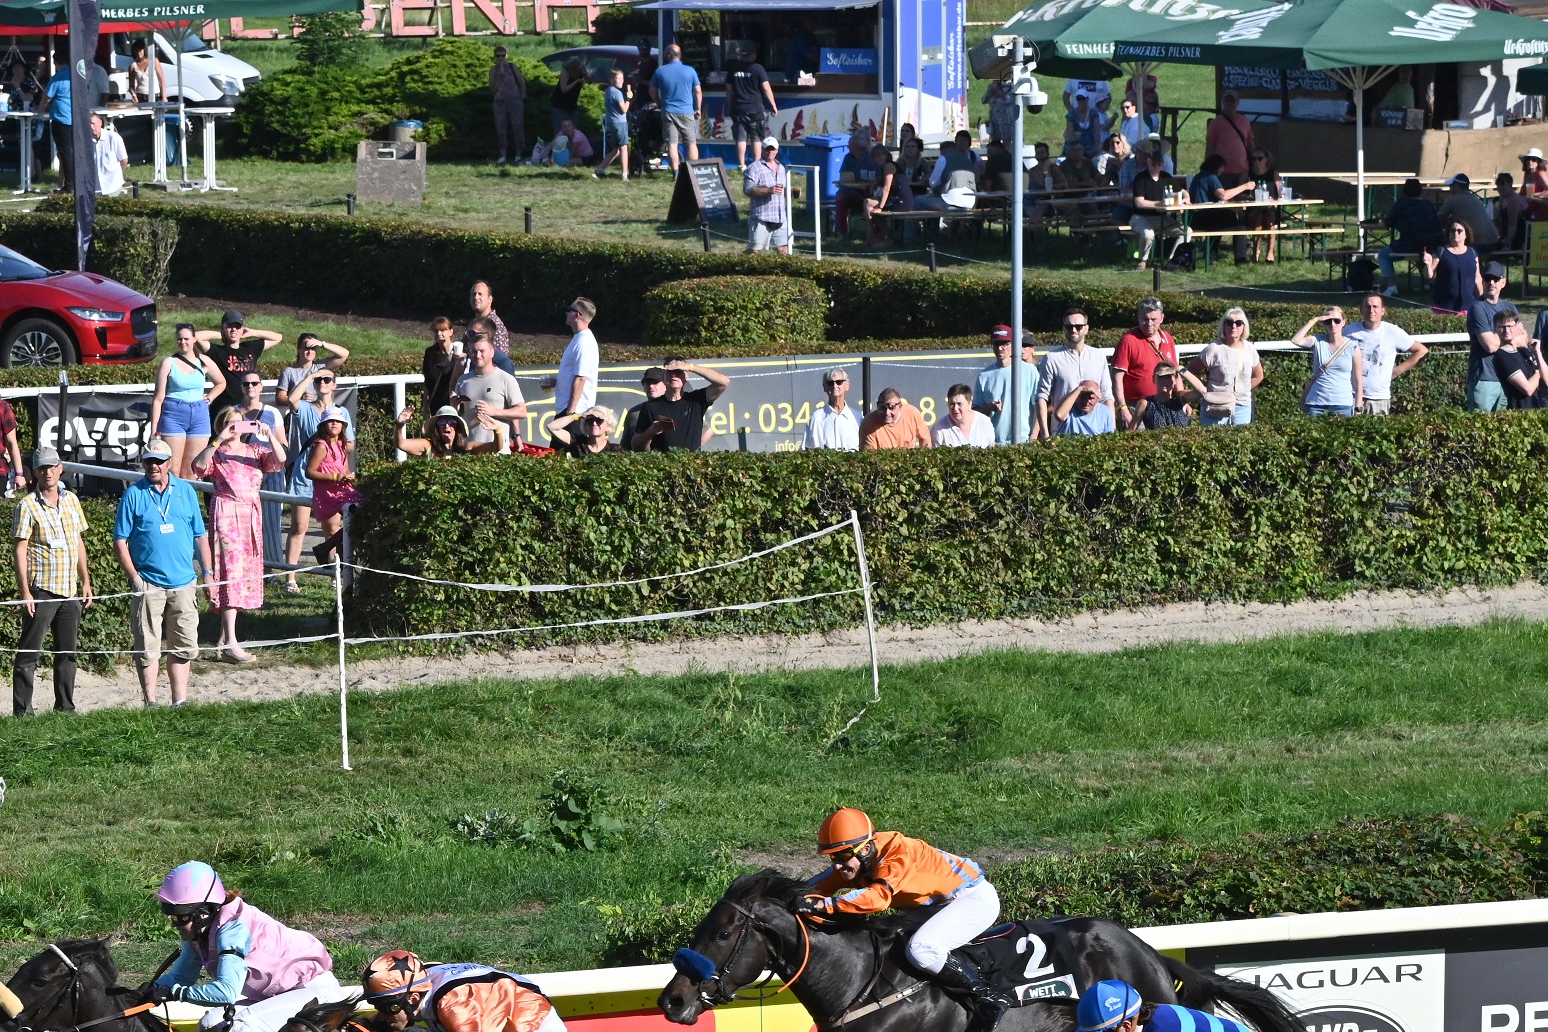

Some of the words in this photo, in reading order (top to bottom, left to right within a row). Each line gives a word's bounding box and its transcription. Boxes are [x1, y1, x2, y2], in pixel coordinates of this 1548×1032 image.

[153, 4, 205, 16] PILSNER
[1117, 45, 1165, 57] FEINHERBES
[1167, 46, 1201, 58] PILSNER
[826, 53, 873, 67] Softeisbar
[1016, 933, 1055, 979] 2
[1029, 984, 1056, 998] WETT
